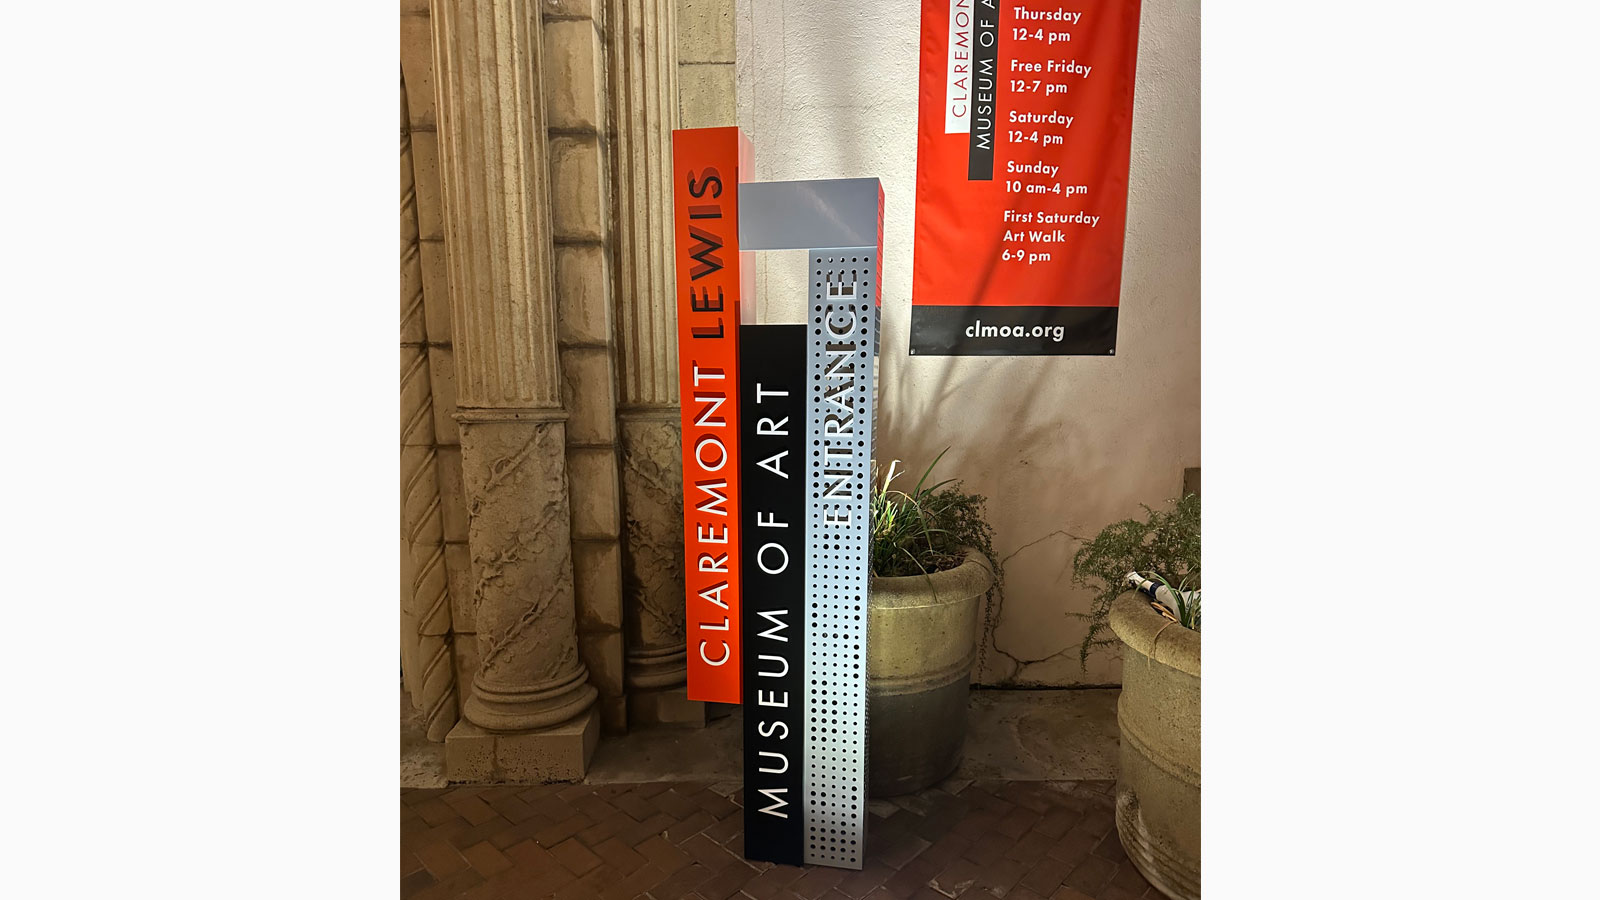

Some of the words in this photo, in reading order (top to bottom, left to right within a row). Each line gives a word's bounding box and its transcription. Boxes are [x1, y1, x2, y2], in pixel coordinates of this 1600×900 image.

[1013, 7, 1082, 25] Thursday
[980, 19, 995, 48] OF
[1012, 28, 1044, 41] 12-4
[1048, 30, 1071, 45] pm
[1010, 59, 1042, 73] Free
[1047, 60, 1092, 78] Friday
[1010, 80, 1041, 93] 12-7
[1046, 82, 1068, 96] pm
[976, 58, 994, 150] MUSEUM
[1009, 110, 1074, 128] Saturday
[1007, 131, 1039, 144] 12-4
[1043, 133, 1064, 147] pm
[1006, 161, 1059, 177] Sunday
[1005, 181, 1022, 194] 10
[1026, 182, 1061, 195] am-4
[1065, 184, 1088, 198] pm
[1003, 210, 1033, 223] First
[1036, 211, 1100, 227] Saturday
[1003, 230, 1026, 242] Art
[1028, 230, 1066, 243] Walk
[688, 168, 724, 339] LEWIS
[1001, 250, 1026, 262] 6-9
[1029, 251, 1051, 264] pm
[965, 320, 1065, 342] clmoa.org
[823, 279, 858, 528] ENTRANCE
[756, 382, 790, 480] ART
[694, 365, 730, 667] CLAREMONT
[756, 512, 790, 576] OF
[757, 609, 790, 820] MUSEUM
